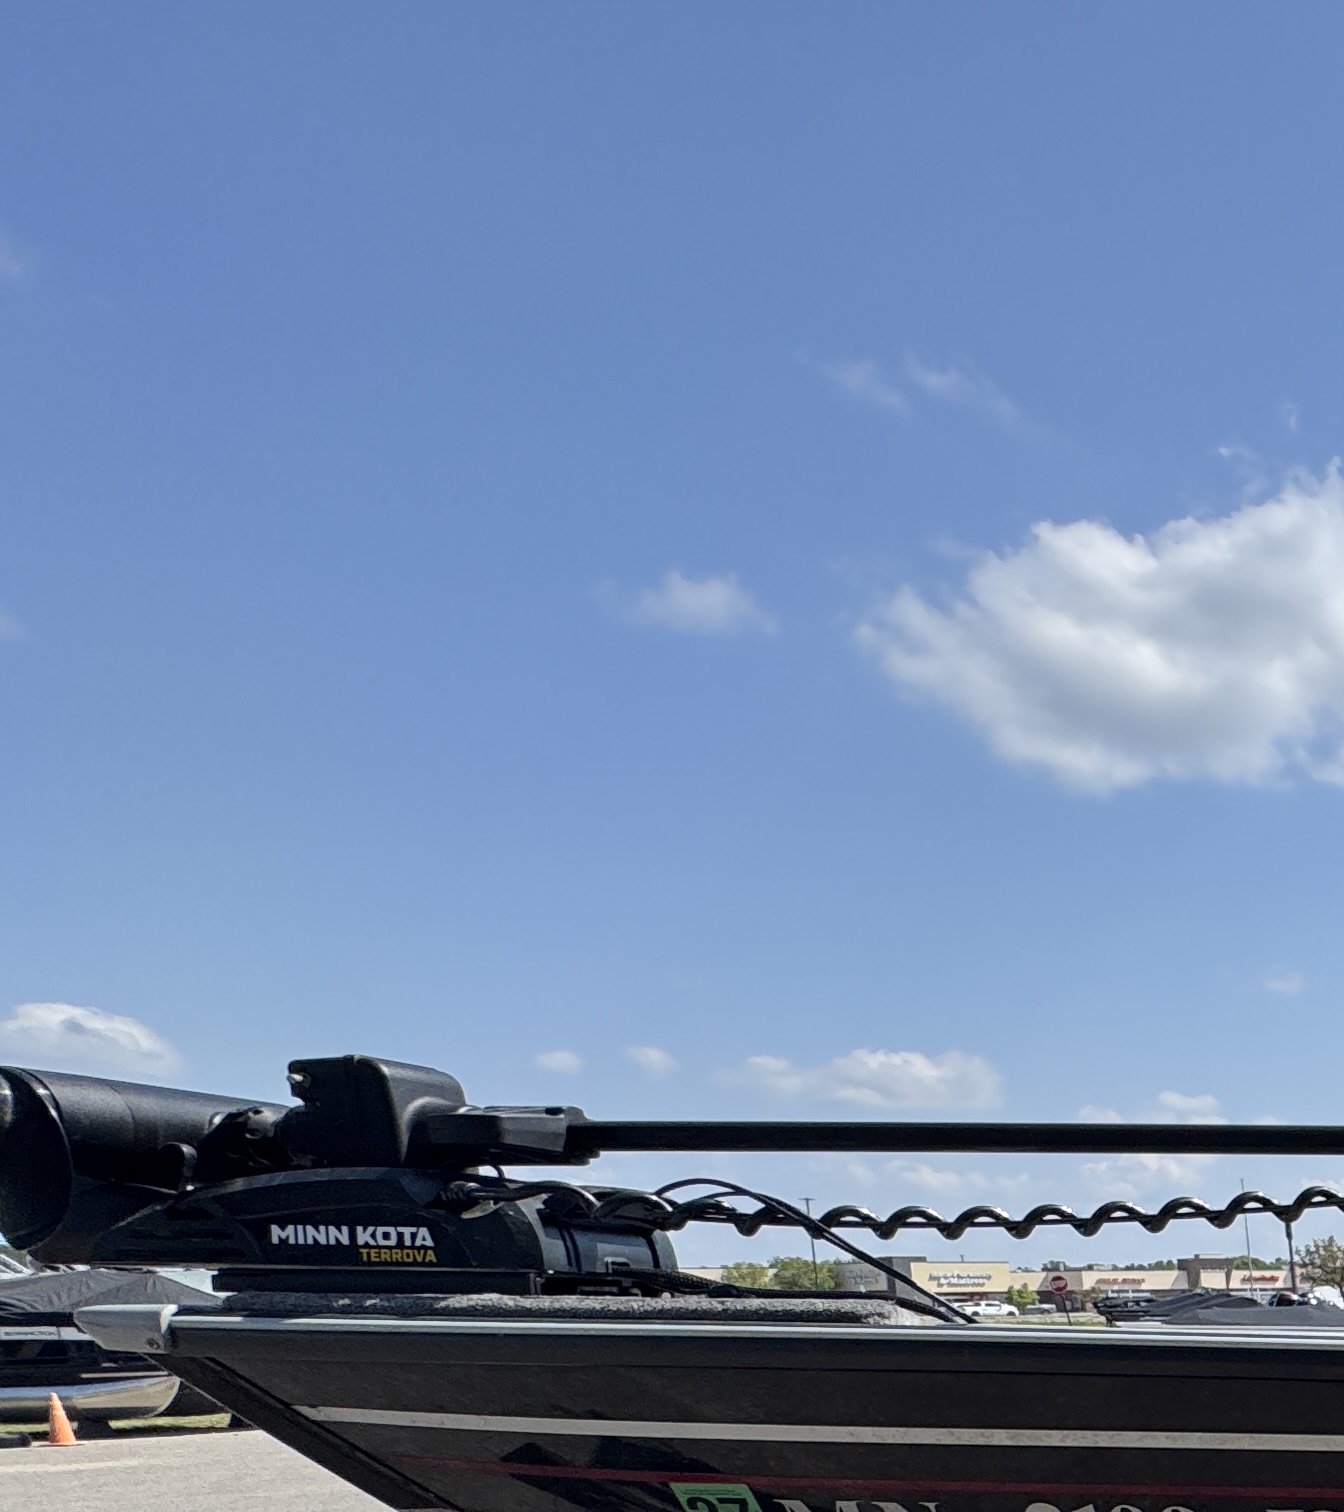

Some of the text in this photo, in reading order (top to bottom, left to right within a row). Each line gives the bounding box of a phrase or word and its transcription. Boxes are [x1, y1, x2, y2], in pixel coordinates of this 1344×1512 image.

[270, 1224, 435, 1247] MINN KOTA
[359, 1248, 437, 1263] TERROVA
